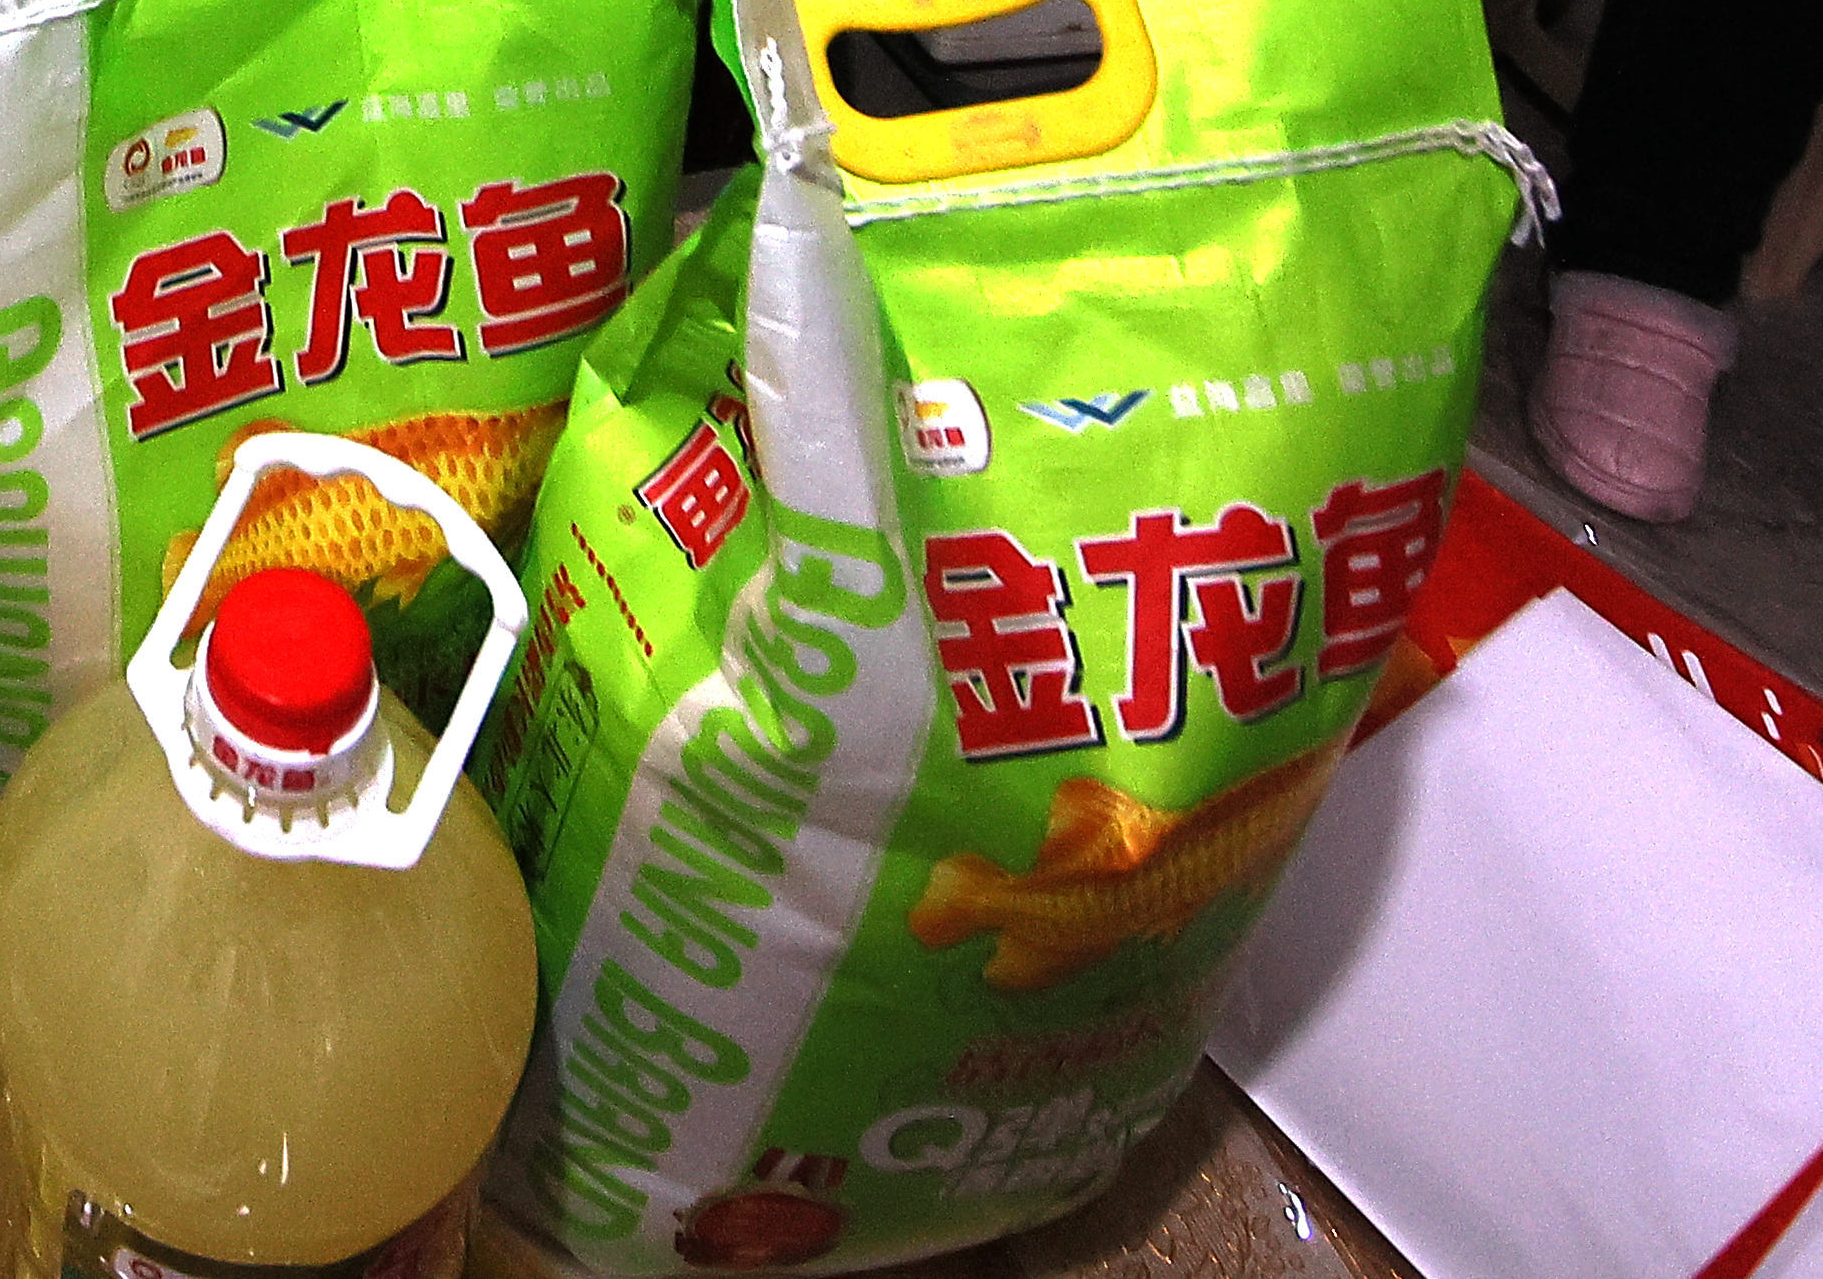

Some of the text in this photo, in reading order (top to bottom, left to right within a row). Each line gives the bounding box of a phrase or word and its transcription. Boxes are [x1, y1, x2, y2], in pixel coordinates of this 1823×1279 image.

[108, 171, 632, 442] 金龙鱼
[922, 468, 1448, 761] 金龙鱼
